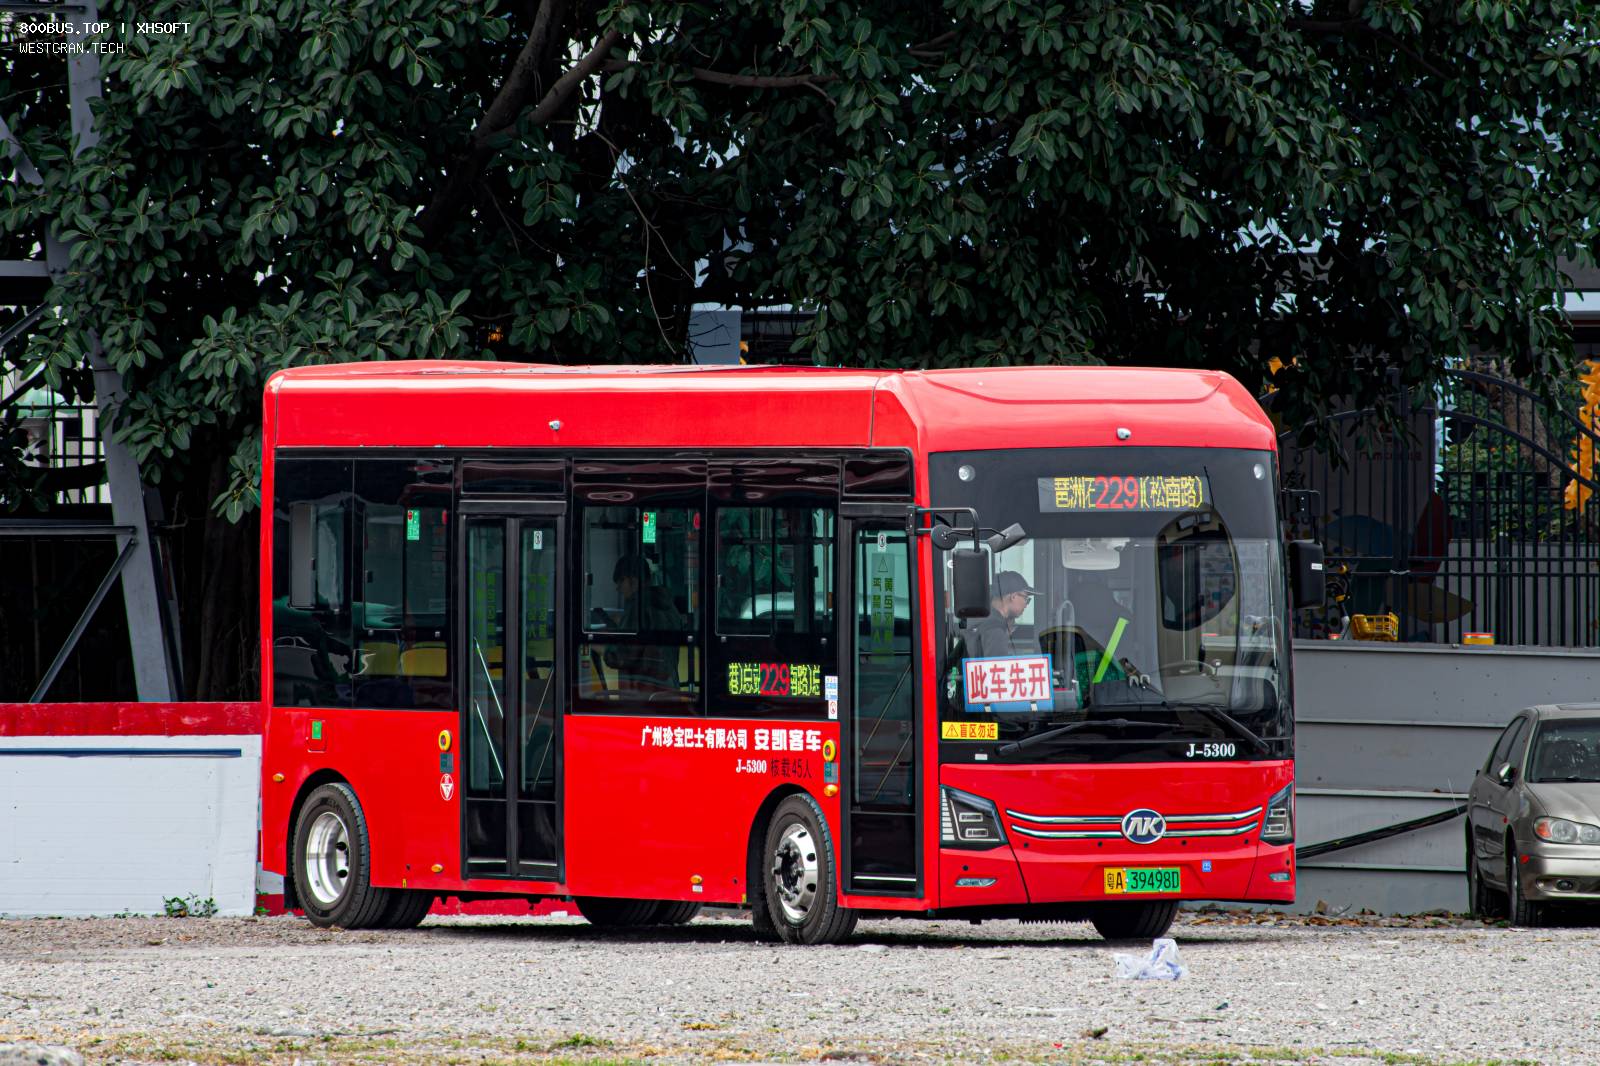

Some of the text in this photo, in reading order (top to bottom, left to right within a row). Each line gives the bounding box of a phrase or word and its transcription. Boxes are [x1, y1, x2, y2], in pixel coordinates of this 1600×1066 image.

[1095, 476, 1138, 508] 229
[760, 663, 790, 696] 229
[970, 662, 1046, 699] 此车先开
[641, 725, 822, 751] 广州珍宝巴士有限公司 安凯客车
[960, 724, 996, 738] 盲区勿近
[1186, 743, 1236, 758] J-5300
[735, 759, 767, 774] J-5300
[1130, 871, 1179, 889] 39498D
